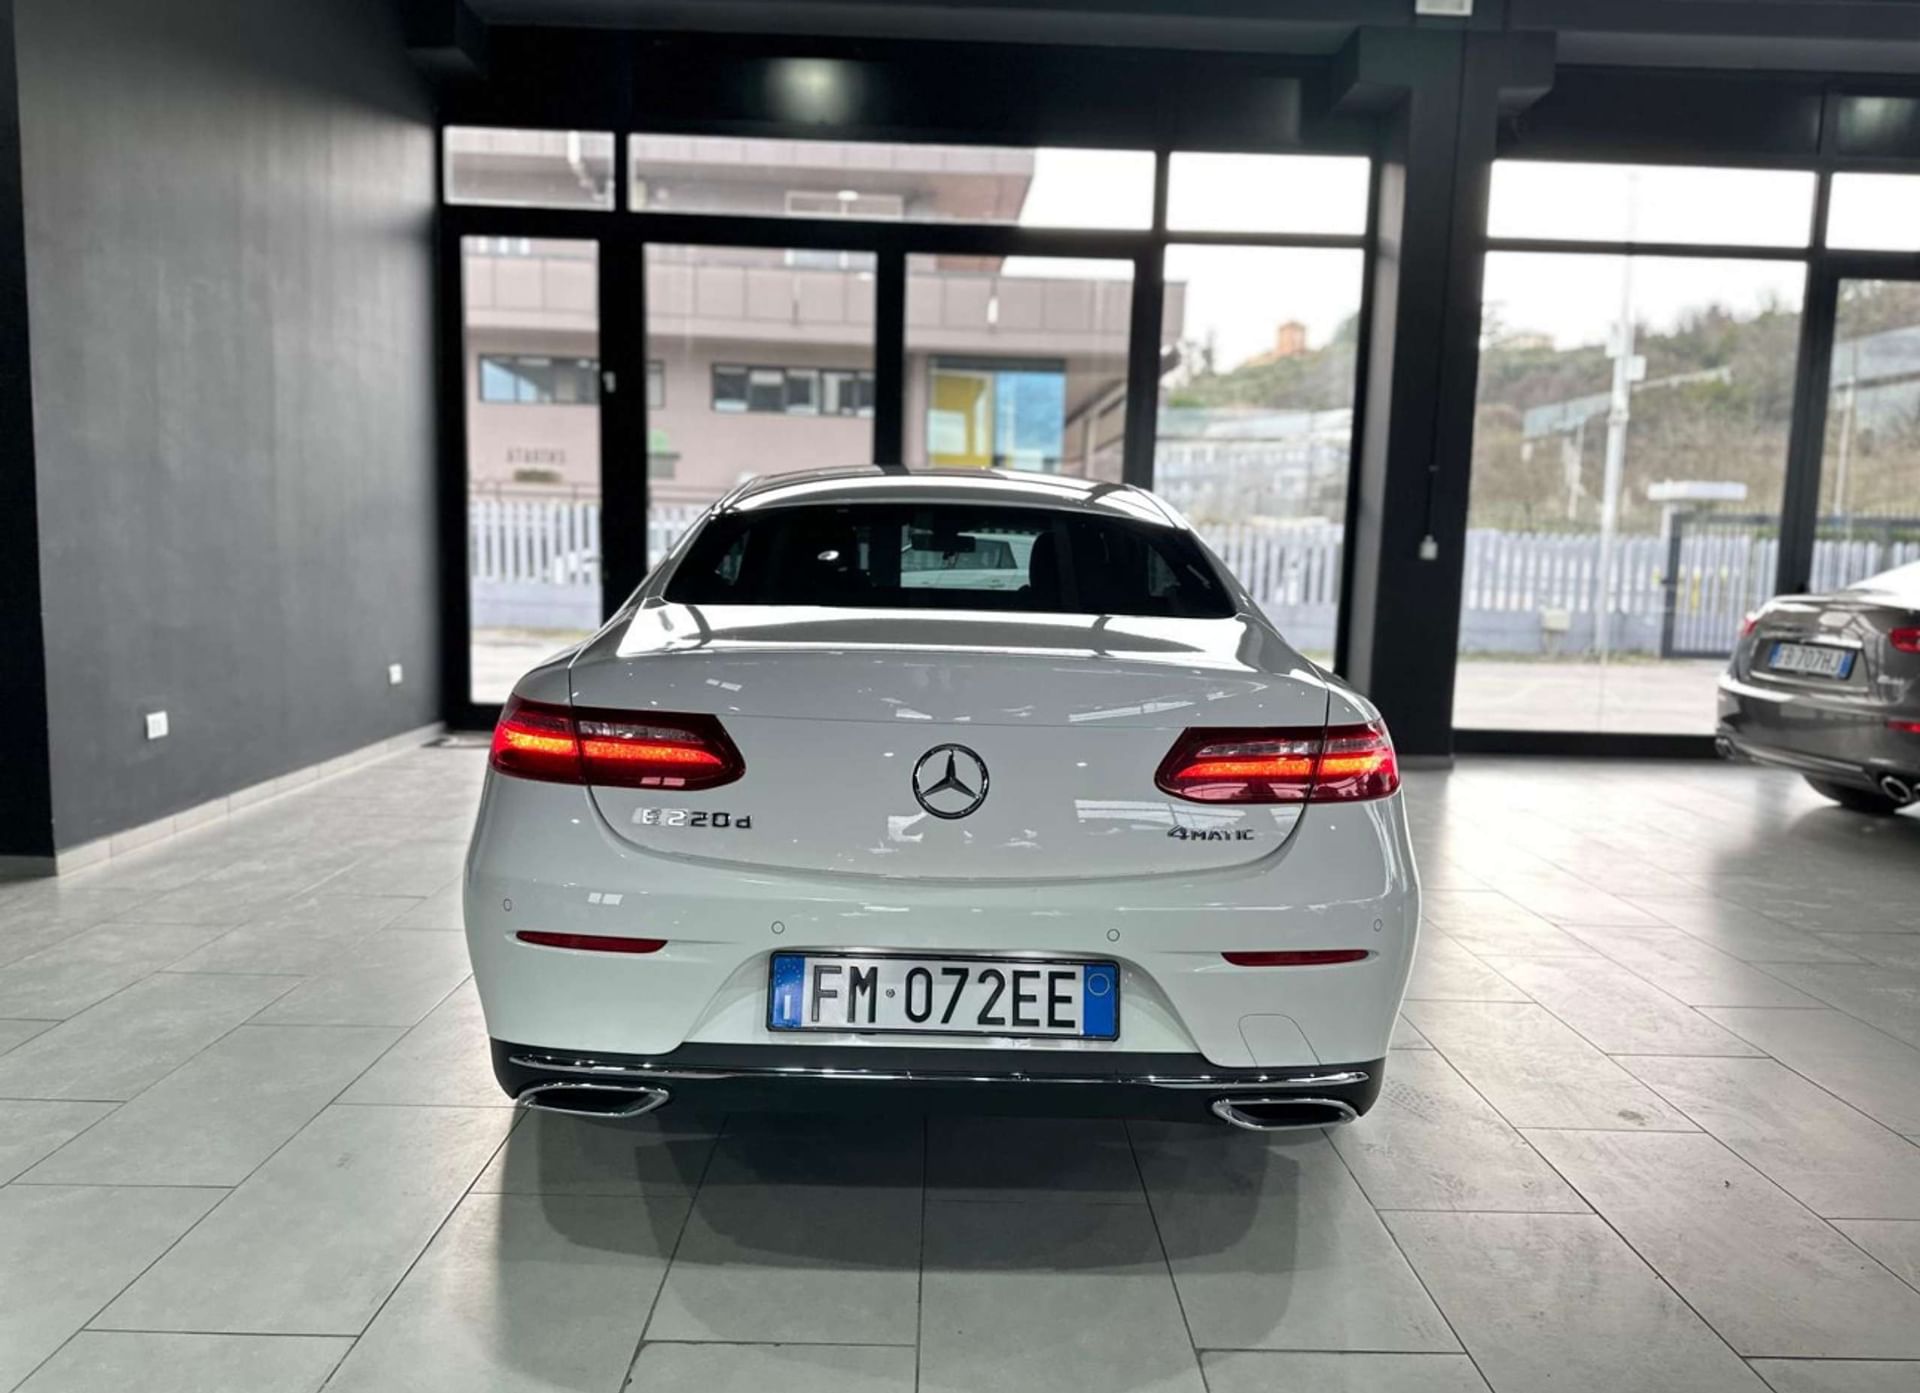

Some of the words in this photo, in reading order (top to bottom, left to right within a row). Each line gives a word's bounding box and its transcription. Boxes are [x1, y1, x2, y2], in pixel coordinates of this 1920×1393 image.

[1167, 825, 1255, 841] 4MATIC
[811, 965, 878, 1023] FM
[905, 966, 1076, 1028] 072EE
